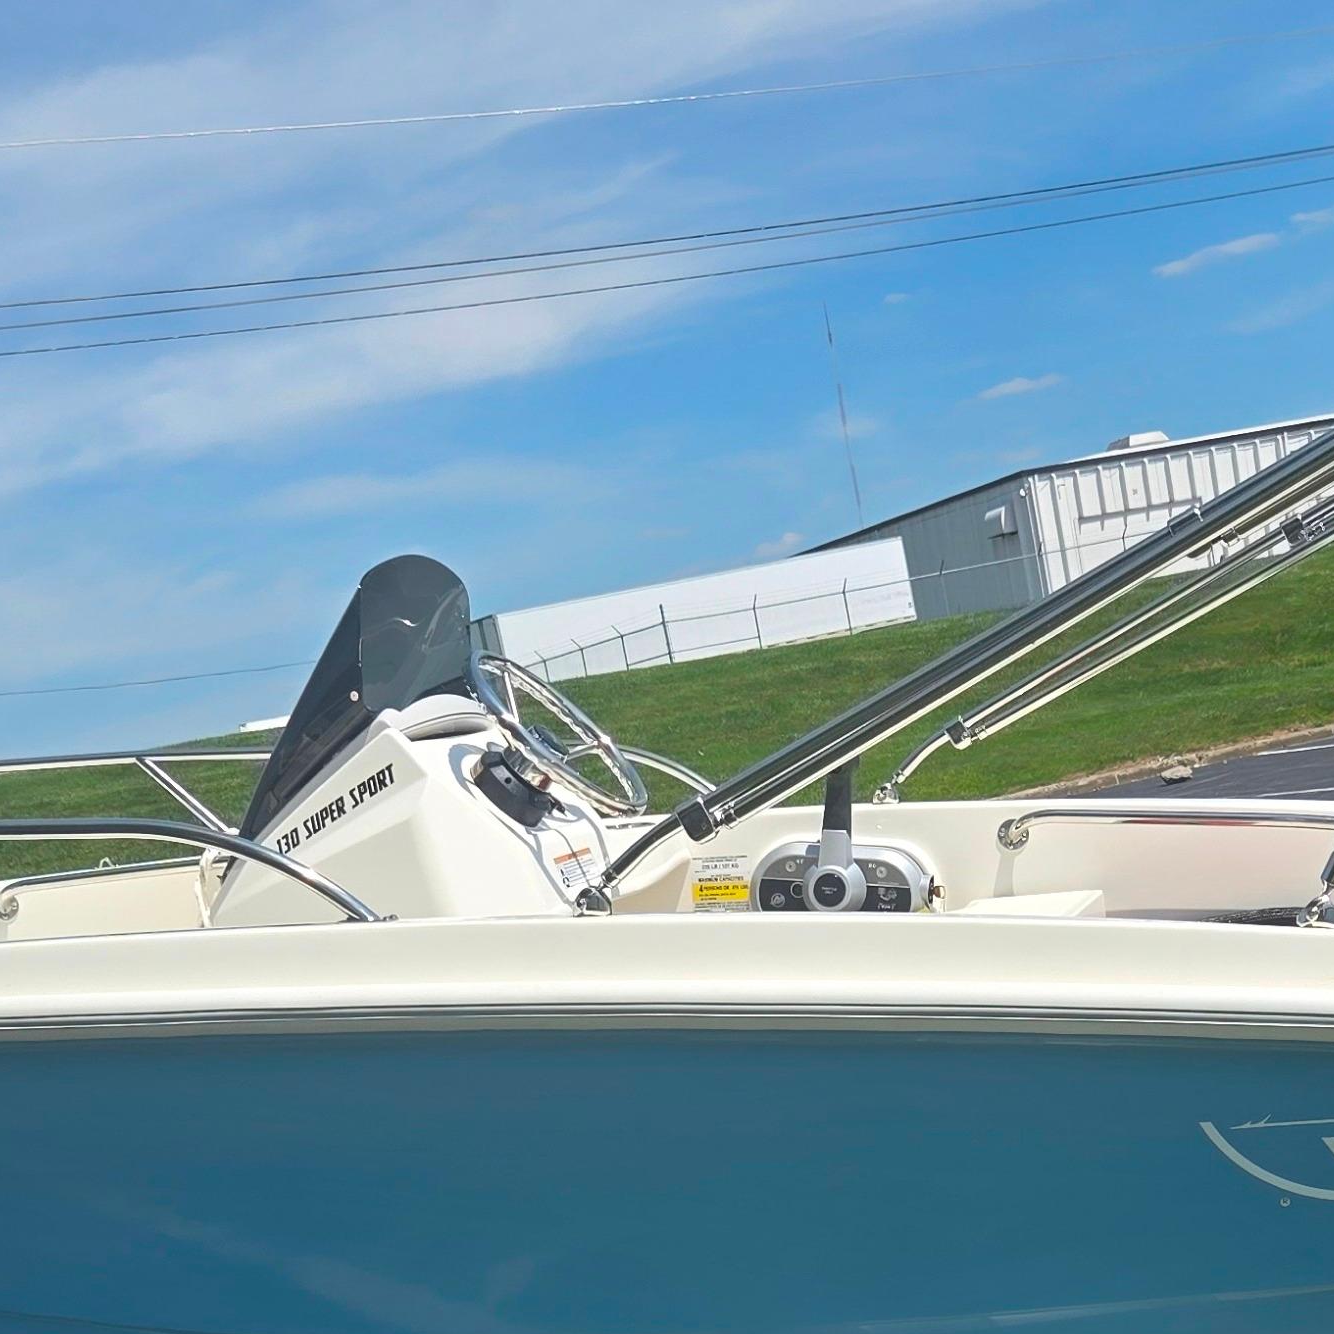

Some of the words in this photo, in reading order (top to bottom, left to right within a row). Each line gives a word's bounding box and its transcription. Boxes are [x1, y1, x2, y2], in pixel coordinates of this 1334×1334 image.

[276, 827, 301, 855] 130
[302, 795, 347, 840] SUPER
[348, 763, 395, 809] SPORT
